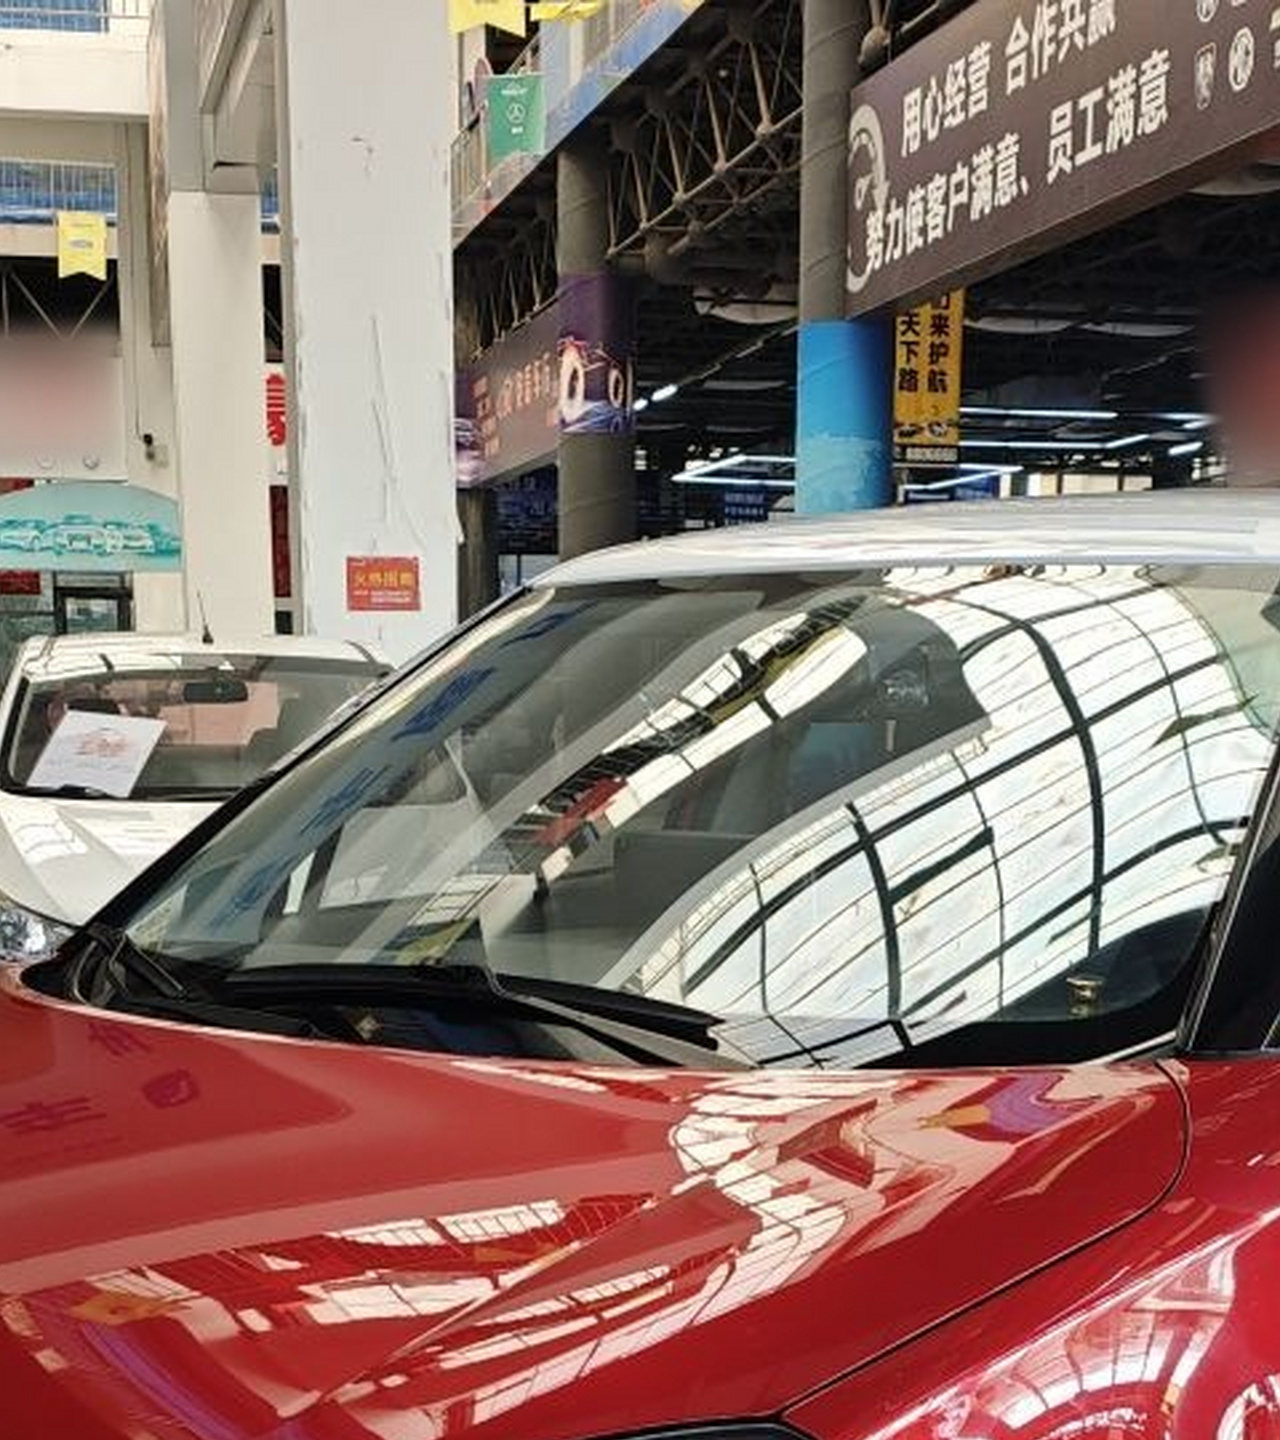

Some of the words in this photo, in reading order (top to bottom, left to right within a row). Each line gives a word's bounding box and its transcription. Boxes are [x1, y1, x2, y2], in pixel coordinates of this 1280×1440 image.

[901, 42, 991, 158] 用心经营
[1046, 49, 1170, 185] 员工满意
